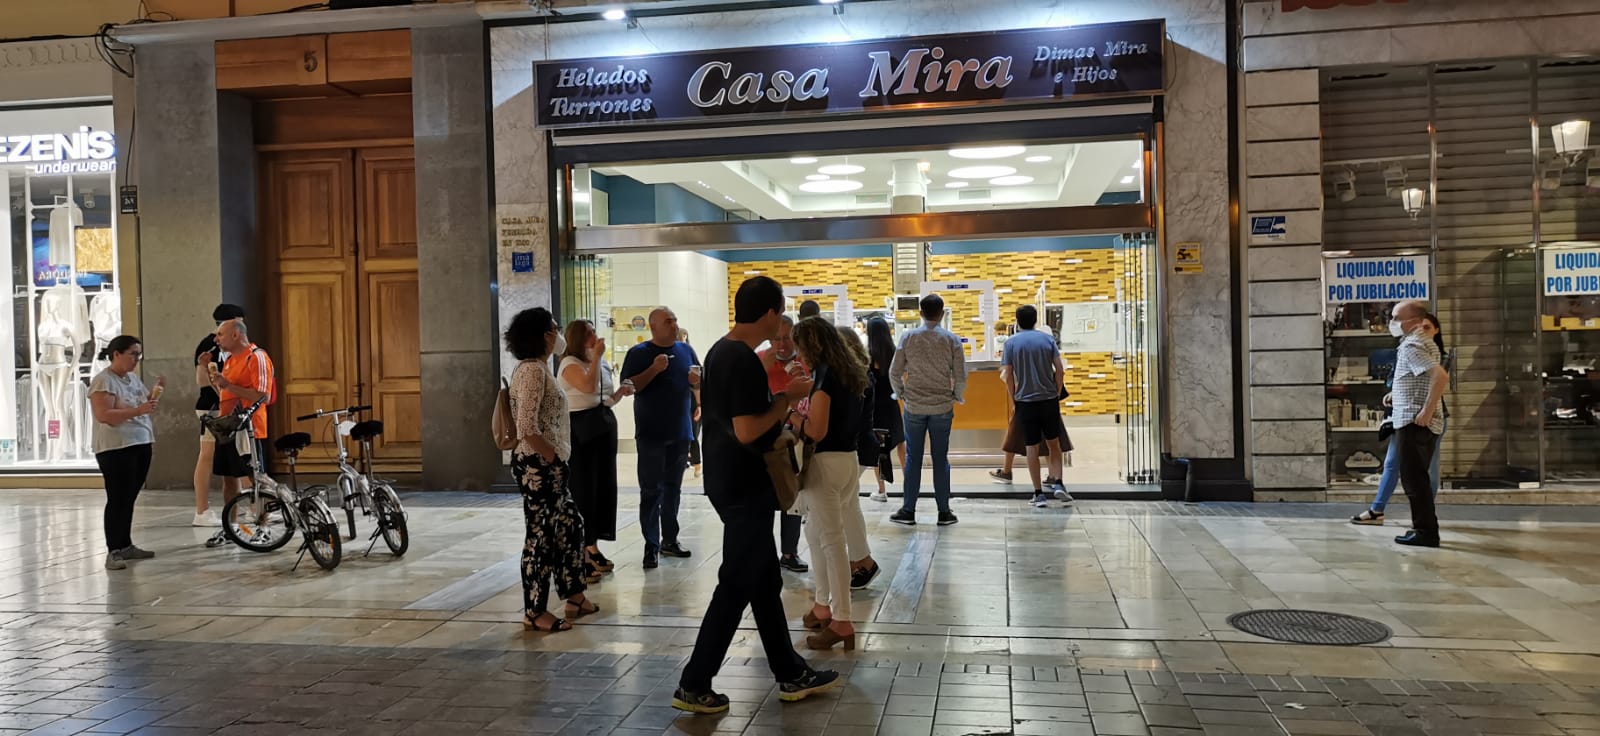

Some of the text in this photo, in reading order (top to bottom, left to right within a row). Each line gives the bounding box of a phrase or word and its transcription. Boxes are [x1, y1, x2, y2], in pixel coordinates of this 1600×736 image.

[304, 49, 318, 72] 5
[1034, 40, 1148, 61] Dimas Mira
[556, 65, 648, 88] Helados
[687, 46, 1014, 107] Casa Mira
[1054, 66, 1118, 84] e Hijos
[550, 97, 653, 117] Turrones
[34, 160, 117, 174] underwear
[1337, 258, 1415, 279] LIQUIDACIÓN
[1555, 252, 1600, 271] LIQUID
[1329, 280, 1426, 300] POR JUBILACIÓN
[1547, 275, 1600, 293] POR JUB
